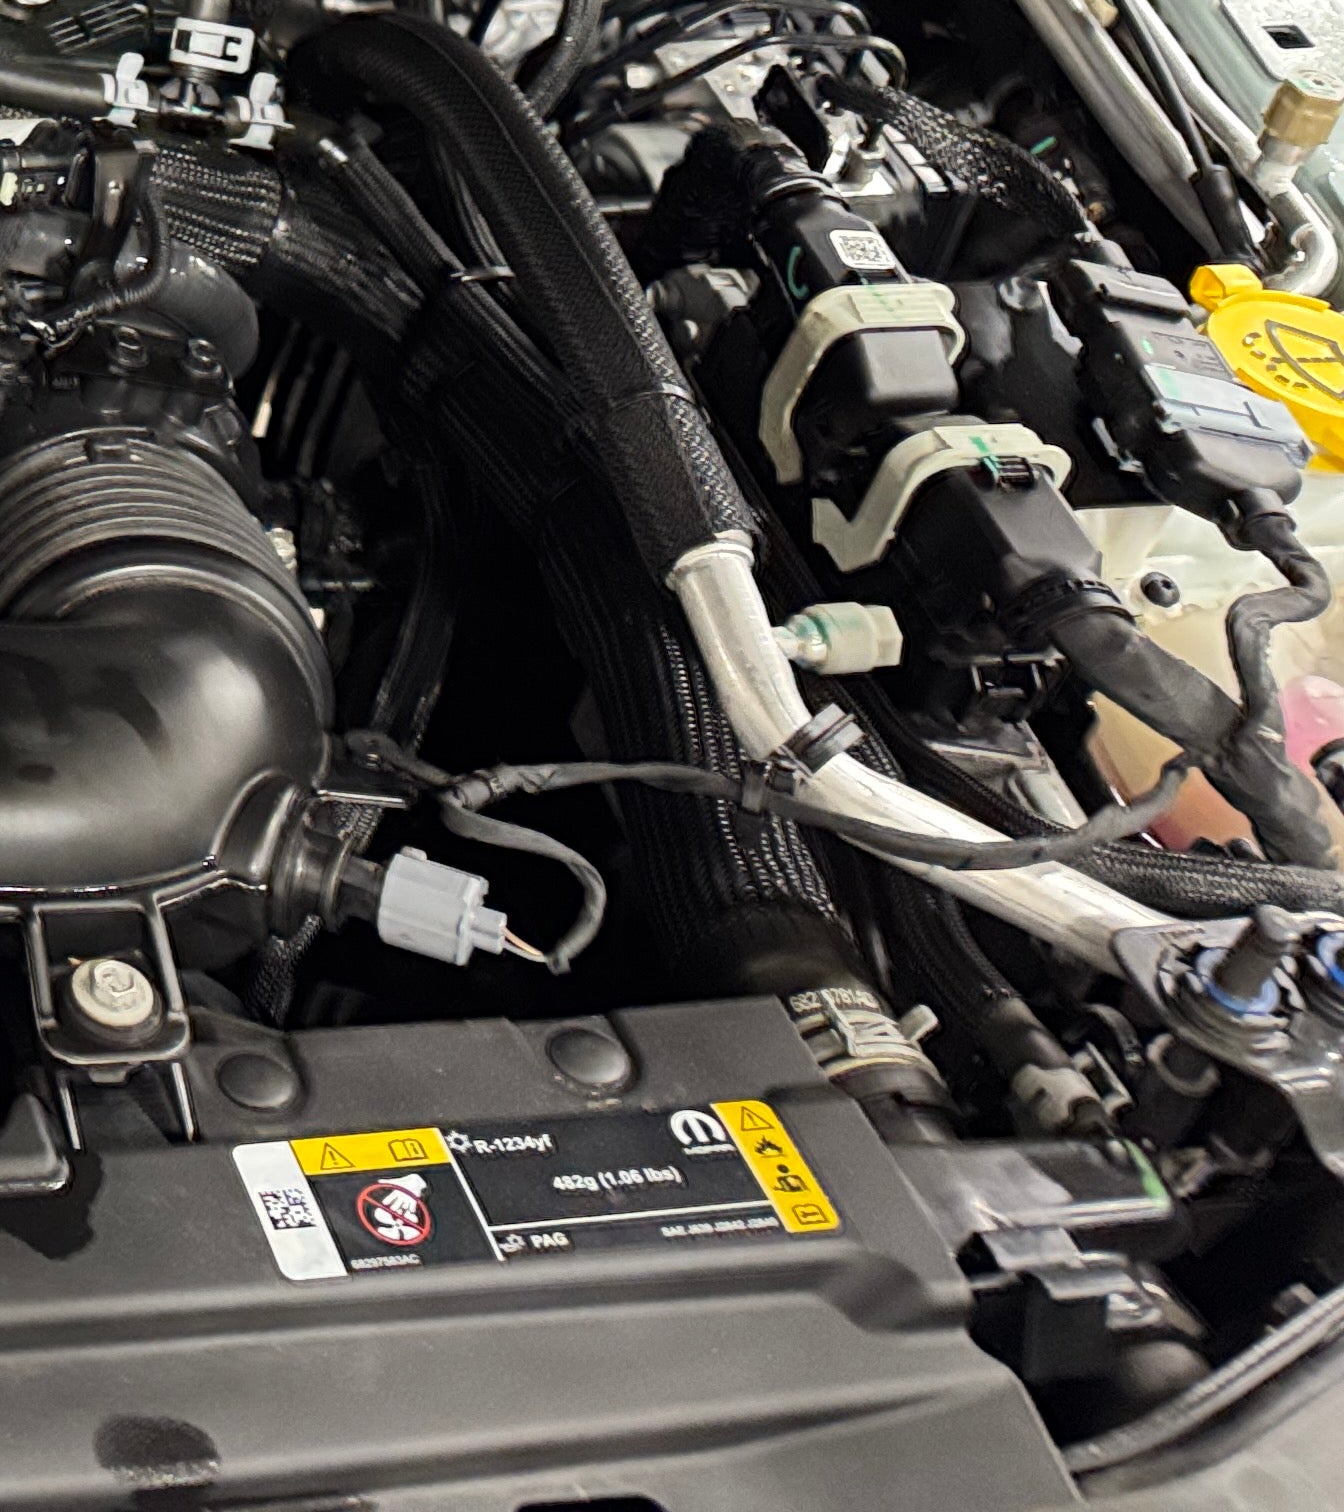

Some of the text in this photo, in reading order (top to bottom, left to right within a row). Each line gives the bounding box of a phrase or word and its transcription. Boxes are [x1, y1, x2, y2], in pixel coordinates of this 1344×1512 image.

[473, 1133, 554, 1155] R-1234yf
[552, 1165, 682, 1192] 482g (1.06 lbs)
[530, 1231, 570, 1249] PAG
